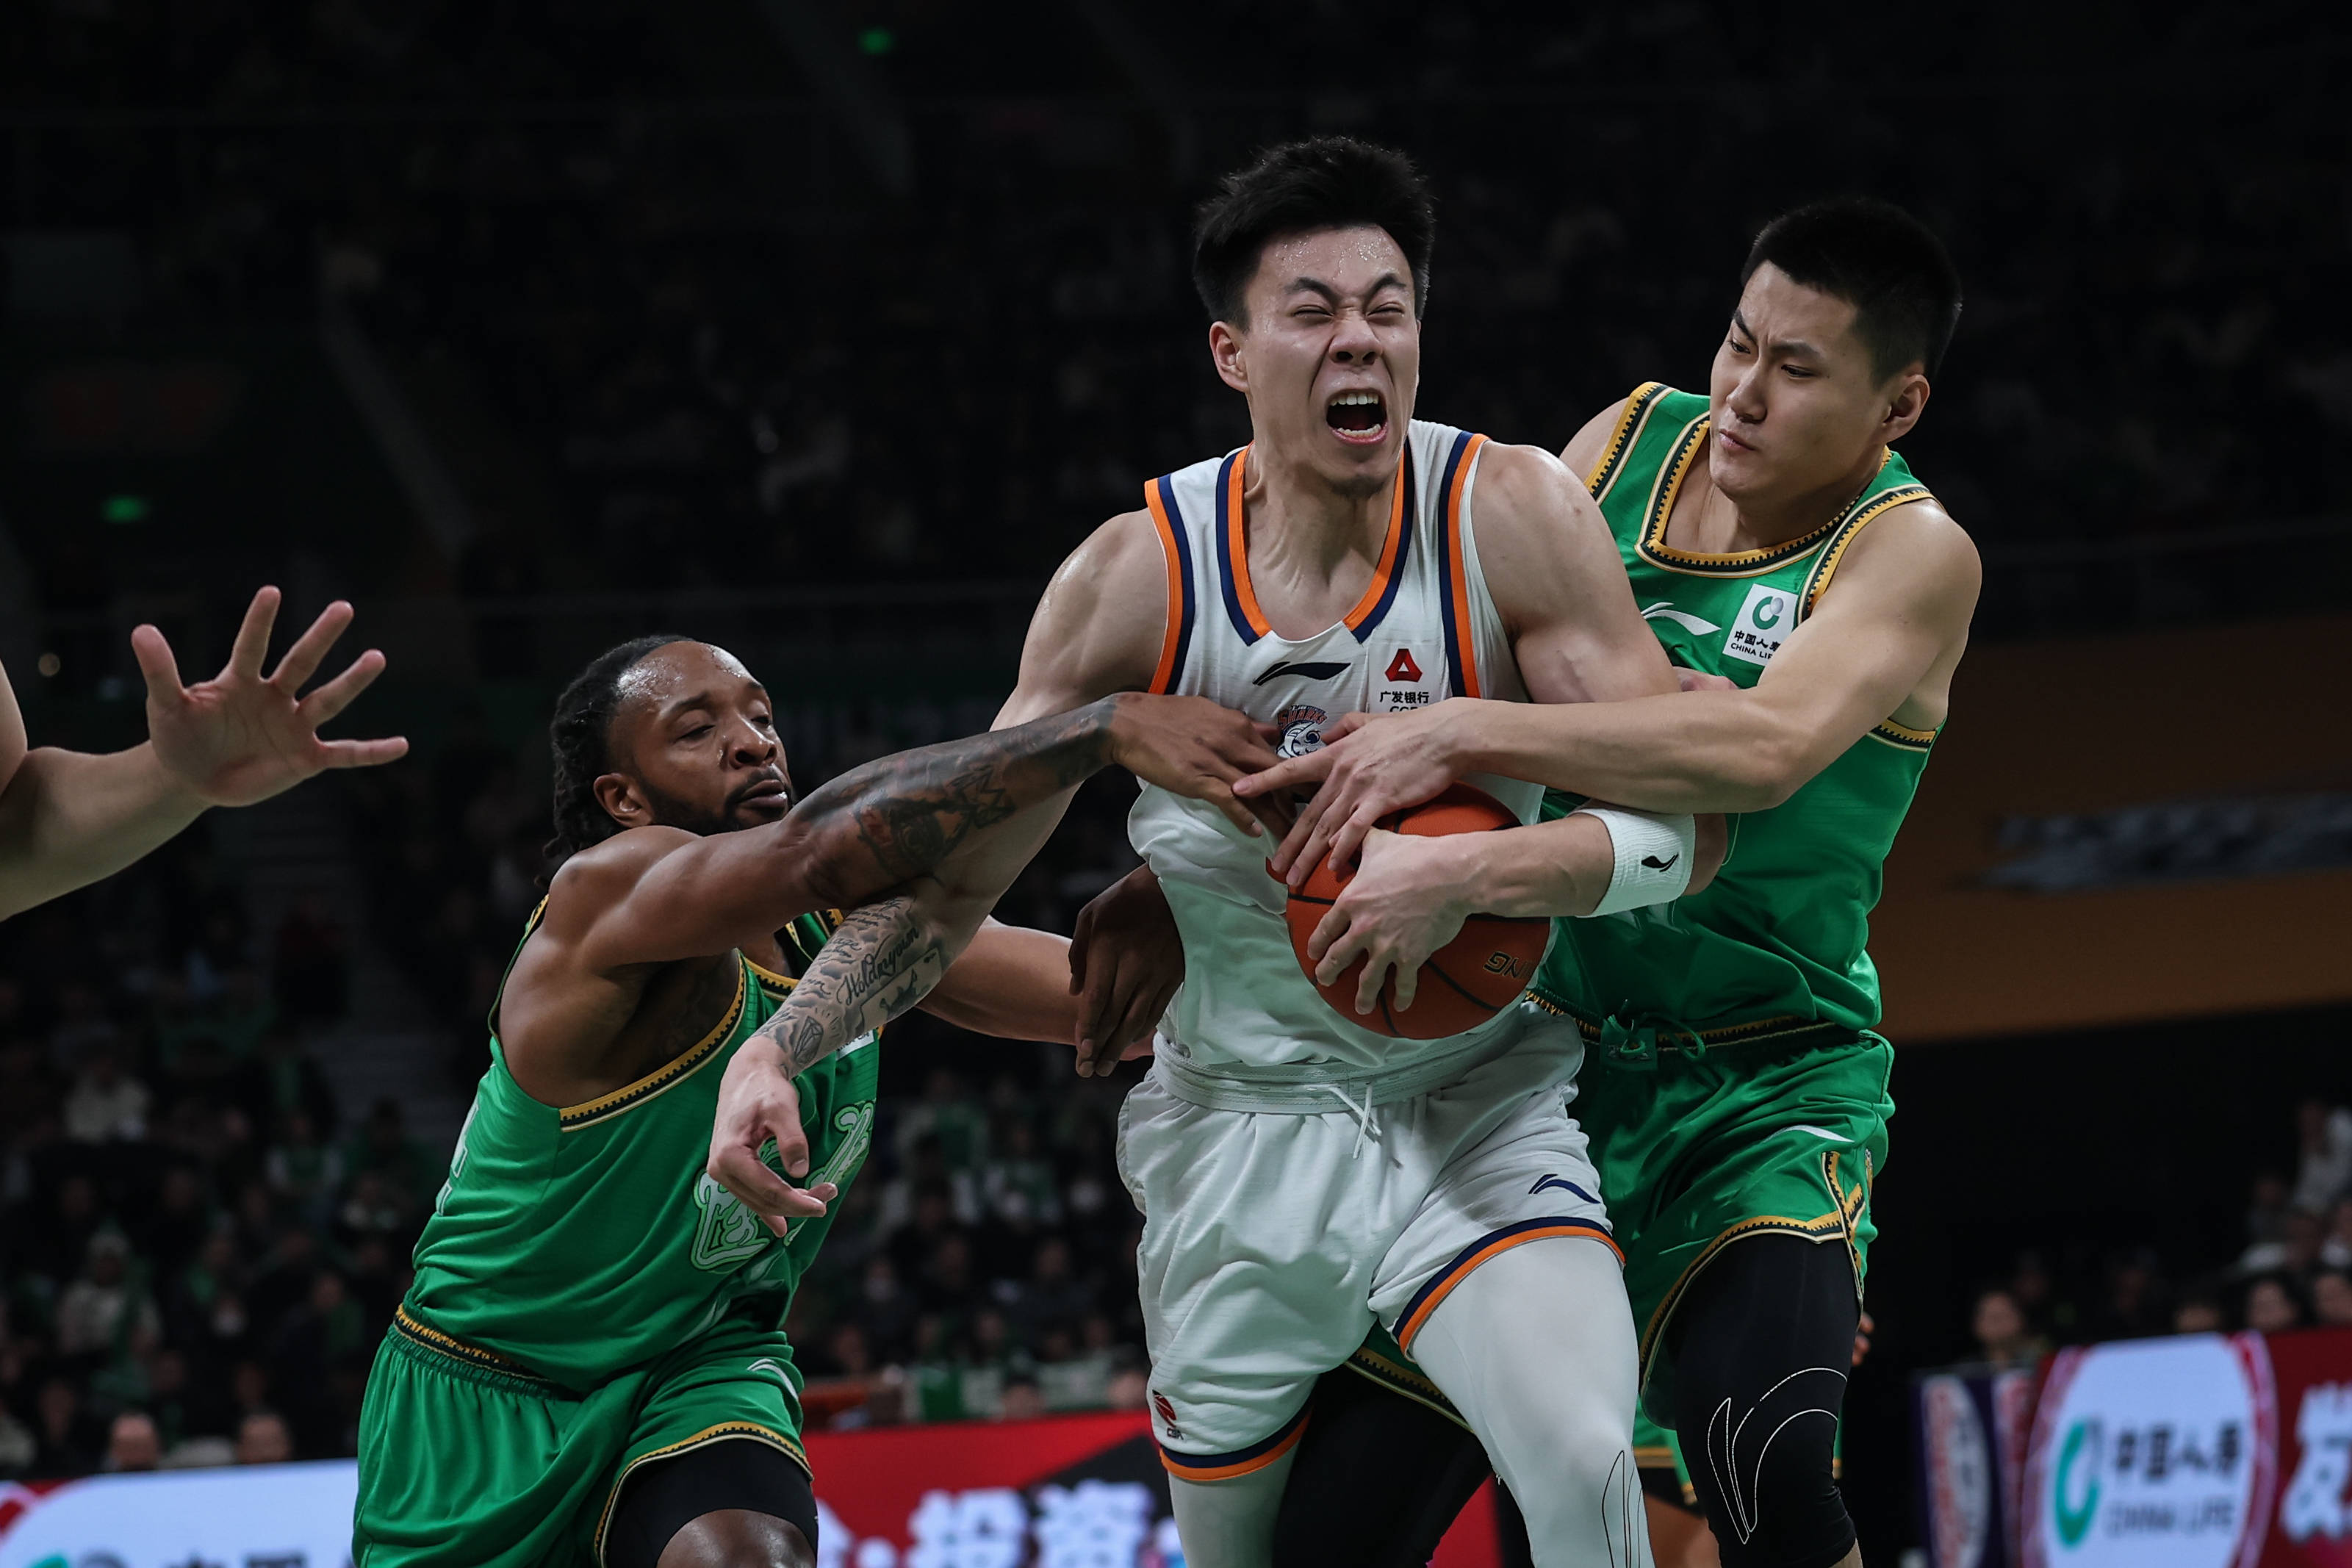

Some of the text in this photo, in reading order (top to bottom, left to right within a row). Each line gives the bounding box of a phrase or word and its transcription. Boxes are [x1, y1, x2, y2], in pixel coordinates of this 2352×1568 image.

[1730, 642, 1772, 660] CHINA LIF
[1379, 691, 1429, 704] 广发银行
[1277, 708, 1328, 730] SHARKS
